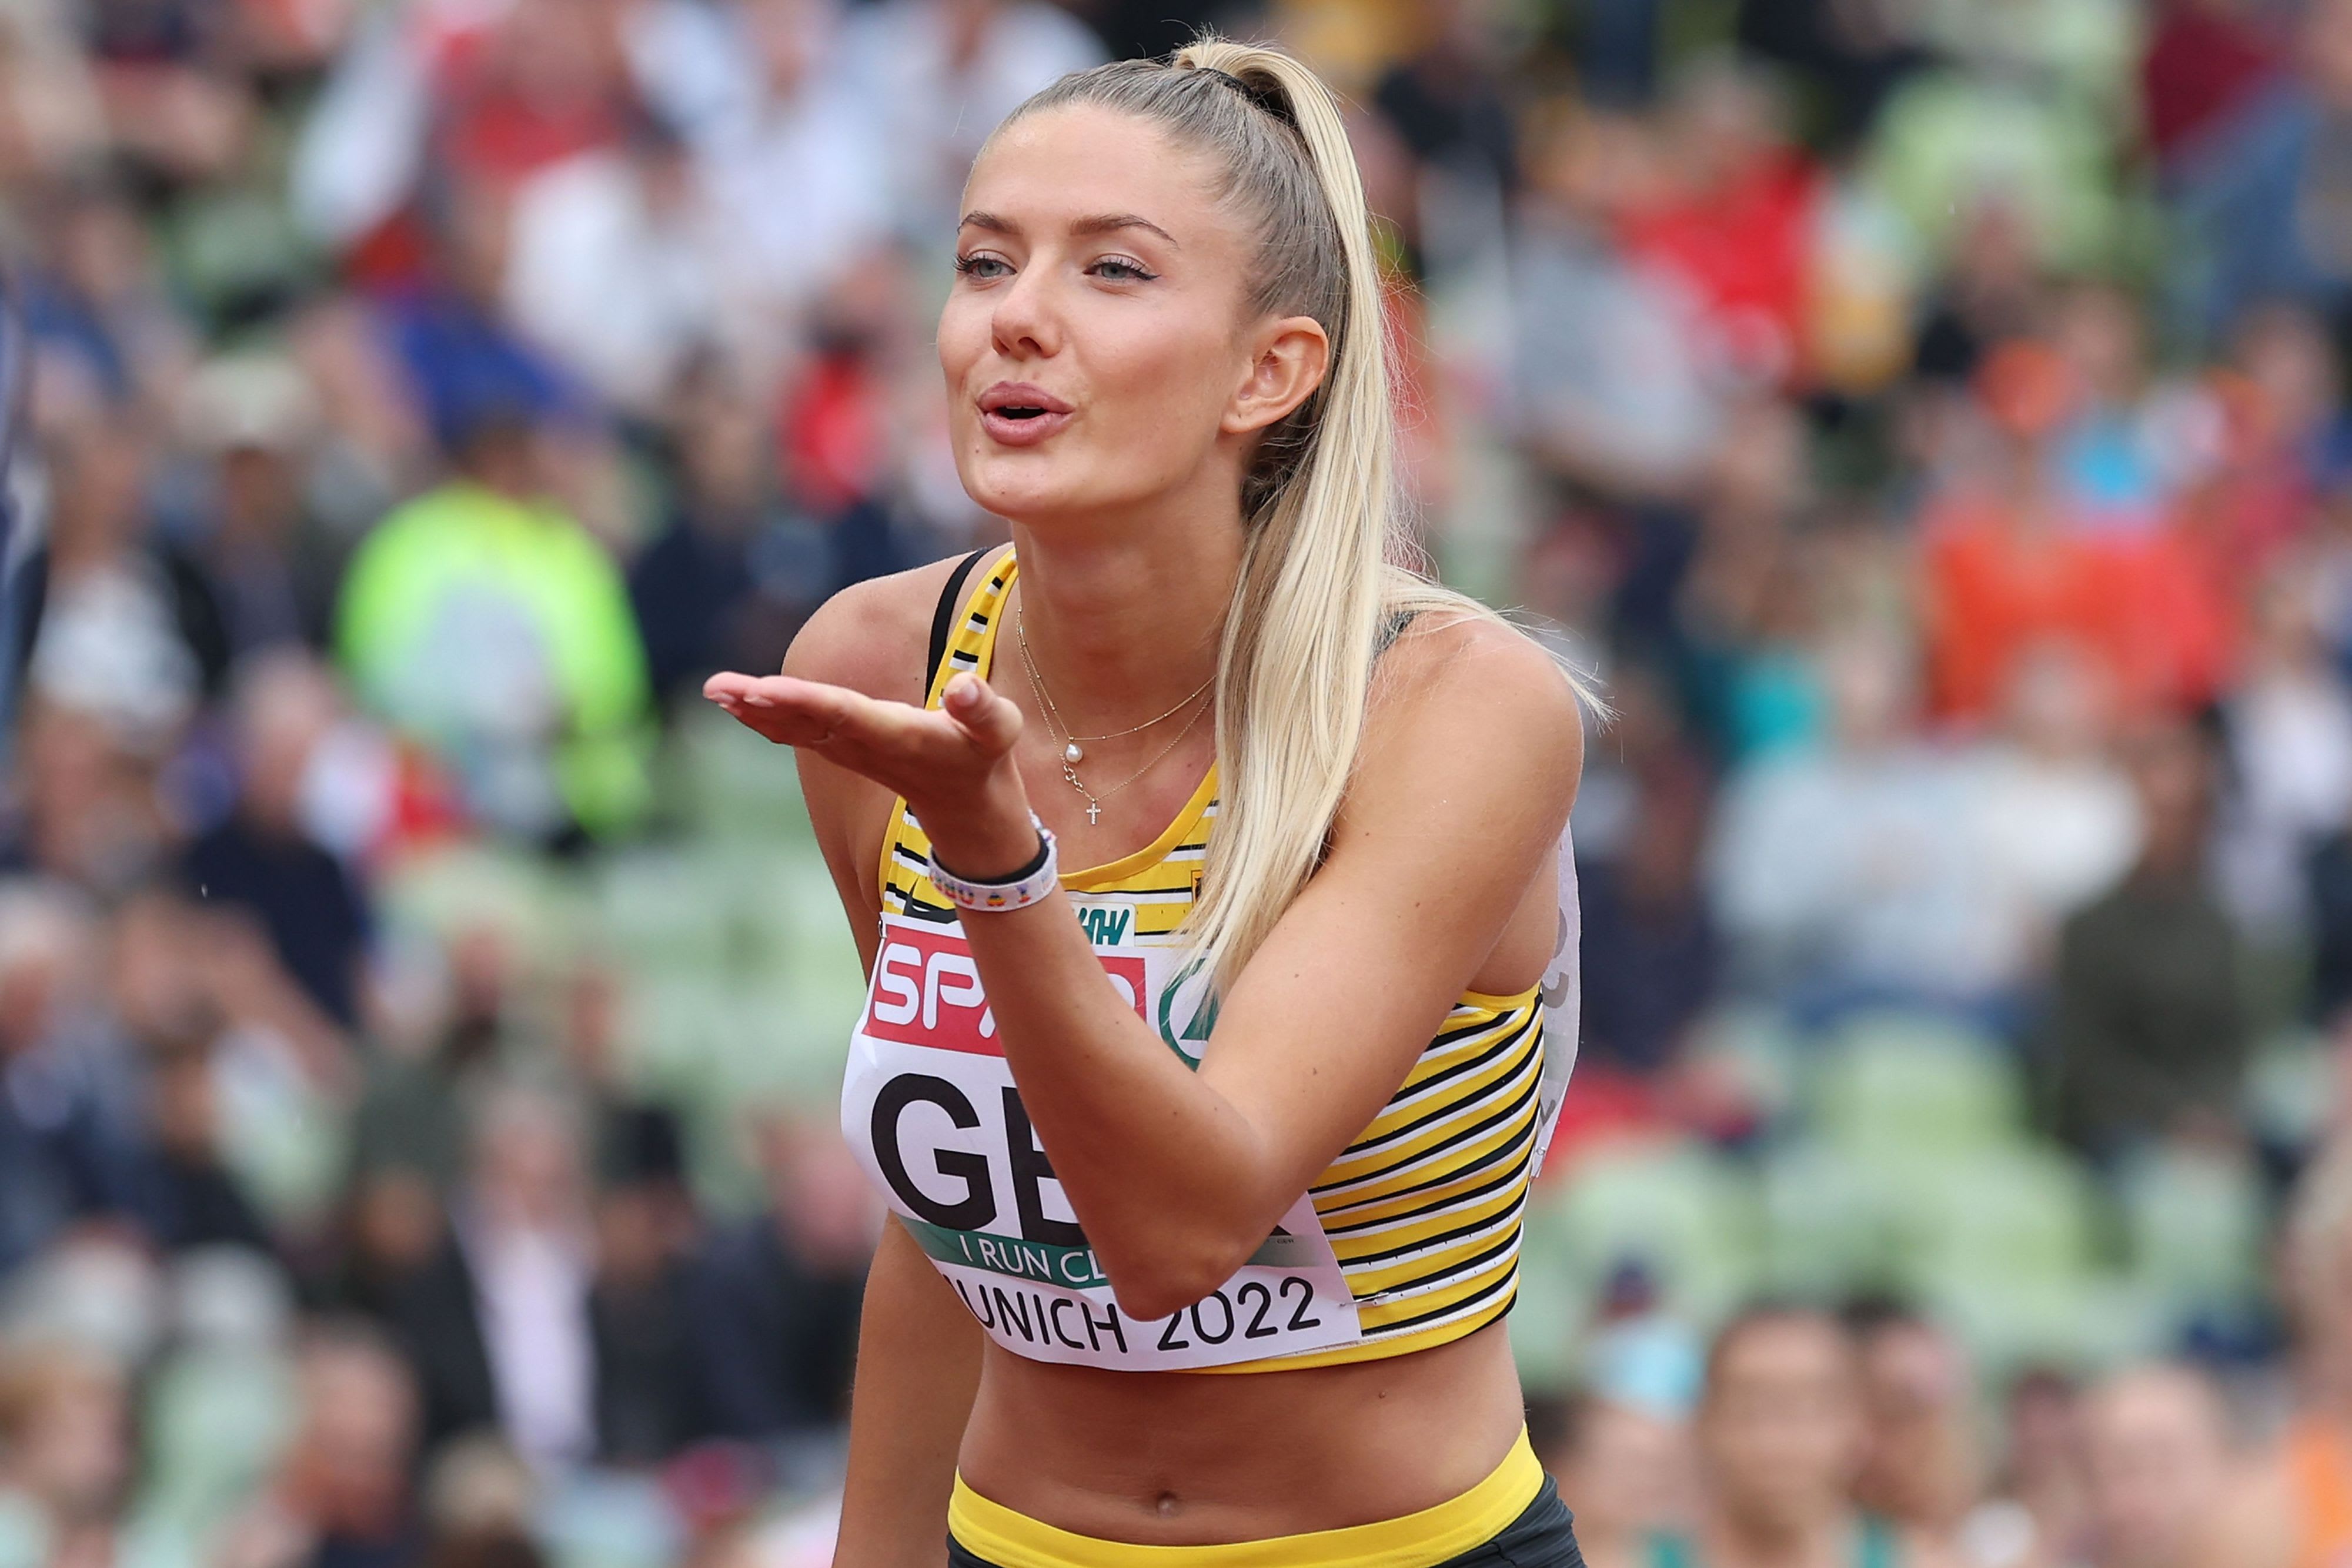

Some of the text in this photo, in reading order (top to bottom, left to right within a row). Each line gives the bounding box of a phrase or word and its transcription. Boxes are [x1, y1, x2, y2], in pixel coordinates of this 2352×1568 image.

[959, 1235, 1107, 1283] I RUN CL
[943, 1273, 1321, 1353] UNICH 2022
